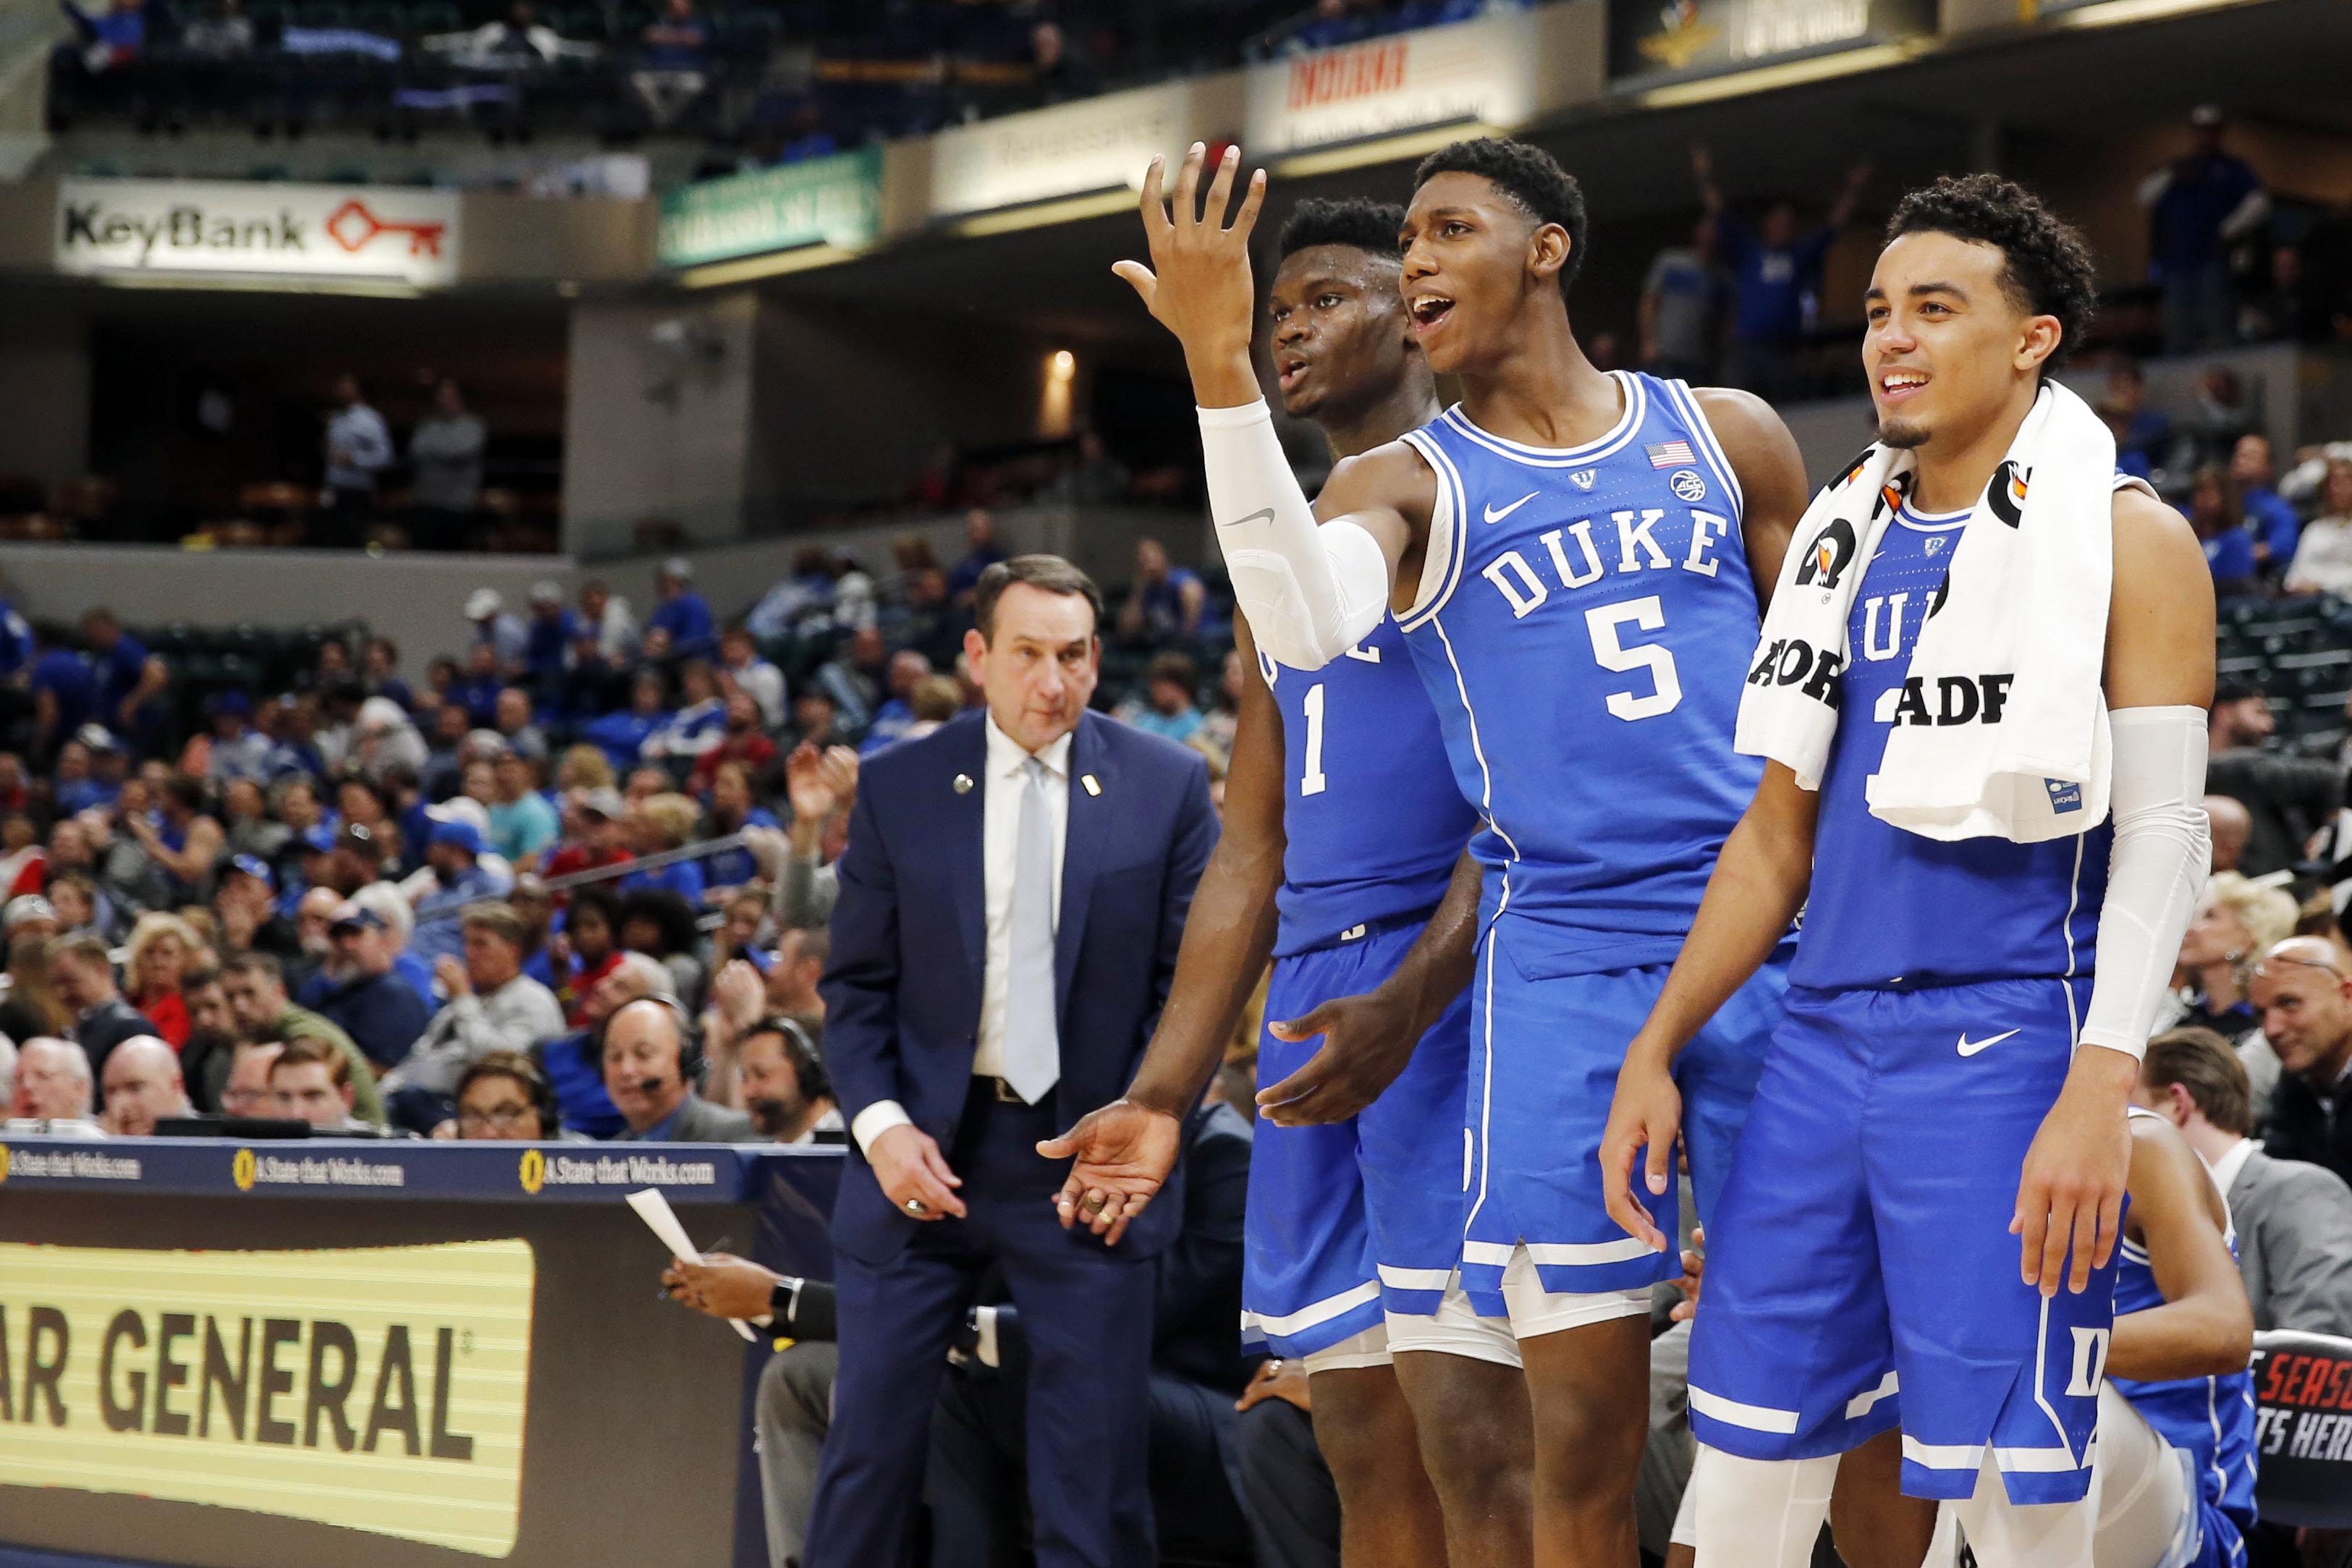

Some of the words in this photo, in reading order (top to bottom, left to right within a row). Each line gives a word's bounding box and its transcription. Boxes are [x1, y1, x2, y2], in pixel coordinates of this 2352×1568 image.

[63, 202, 306, 266] KeyBank
[1676, 478, 1701, 489] ACC
[1481, 509, 1727, 620] DUKE
[1583, 595, 1683, 722] 5
[1300, 683, 1327, 797] 1
[557, 1157, 597, 1185] State
[596, 1156, 629, 1185] that
[628, 1156, 715, 1185] Works.com
[0, 1305, 71, 1428] R
[98, 1308, 475, 1460] GENERAL
